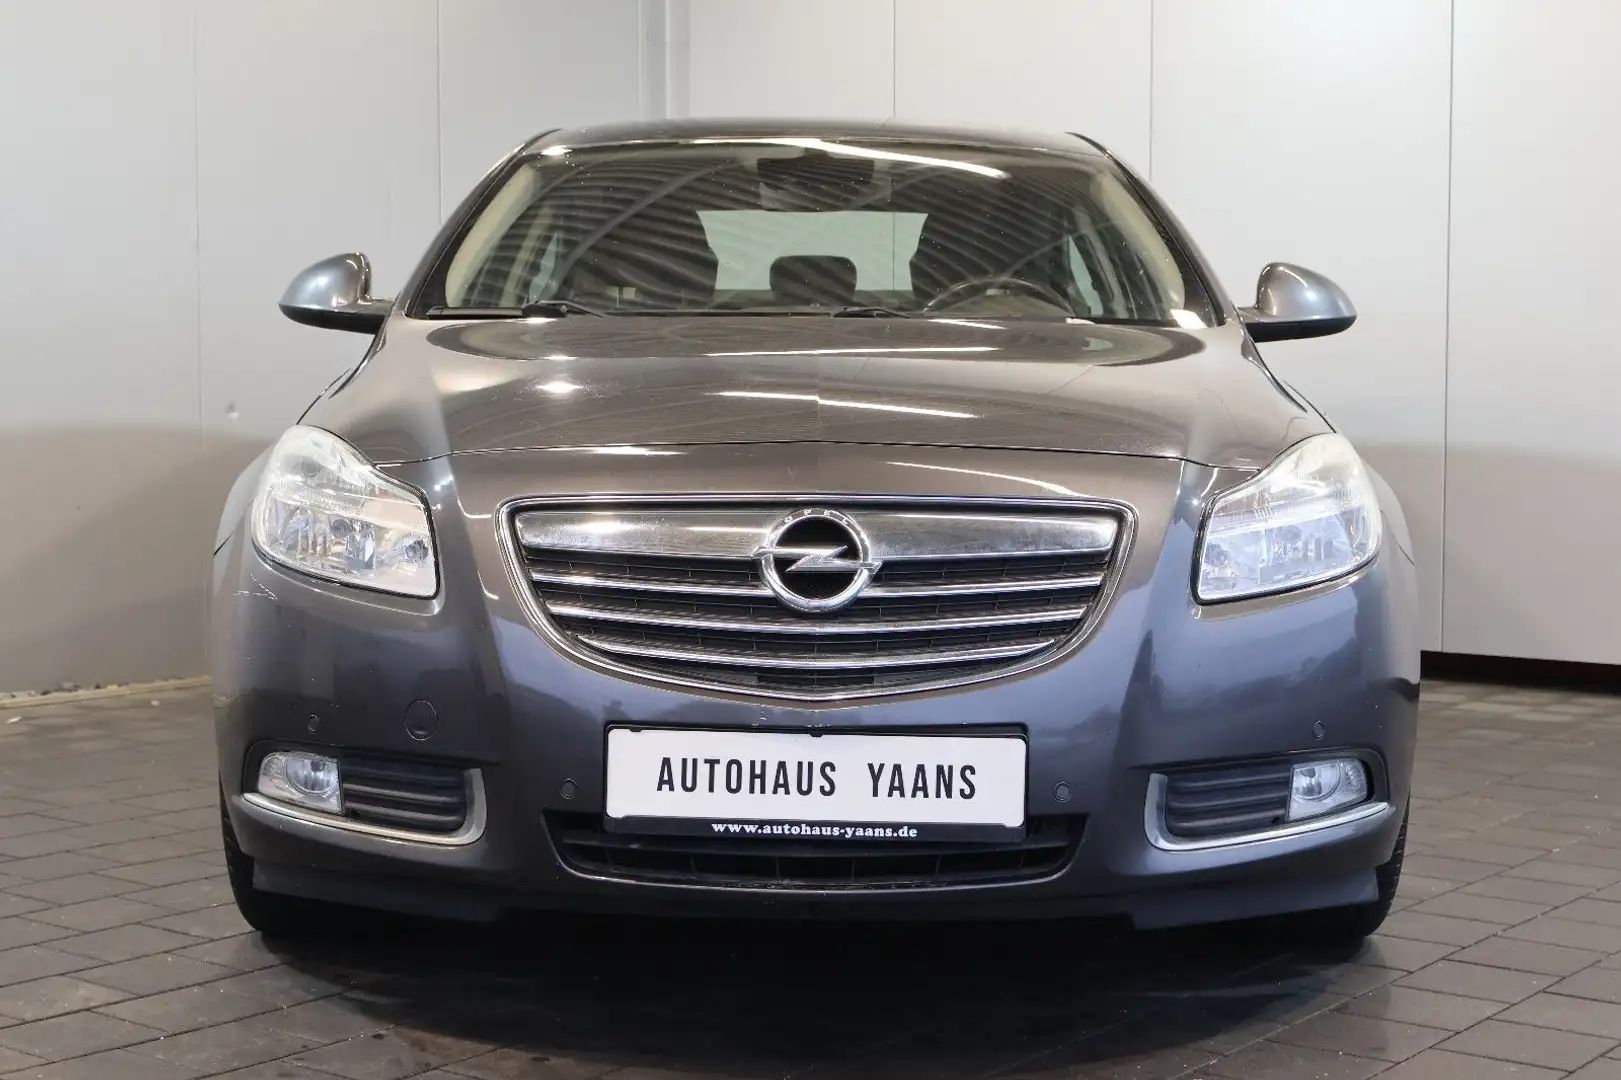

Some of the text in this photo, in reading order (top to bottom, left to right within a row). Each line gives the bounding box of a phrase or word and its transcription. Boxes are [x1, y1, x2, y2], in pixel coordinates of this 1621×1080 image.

[784, 508, 849, 525] OPEL
[656, 756, 977, 800] AUTOHAUS YAANS
[711, 822, 918, 839] www.autohaus-yaans.de
